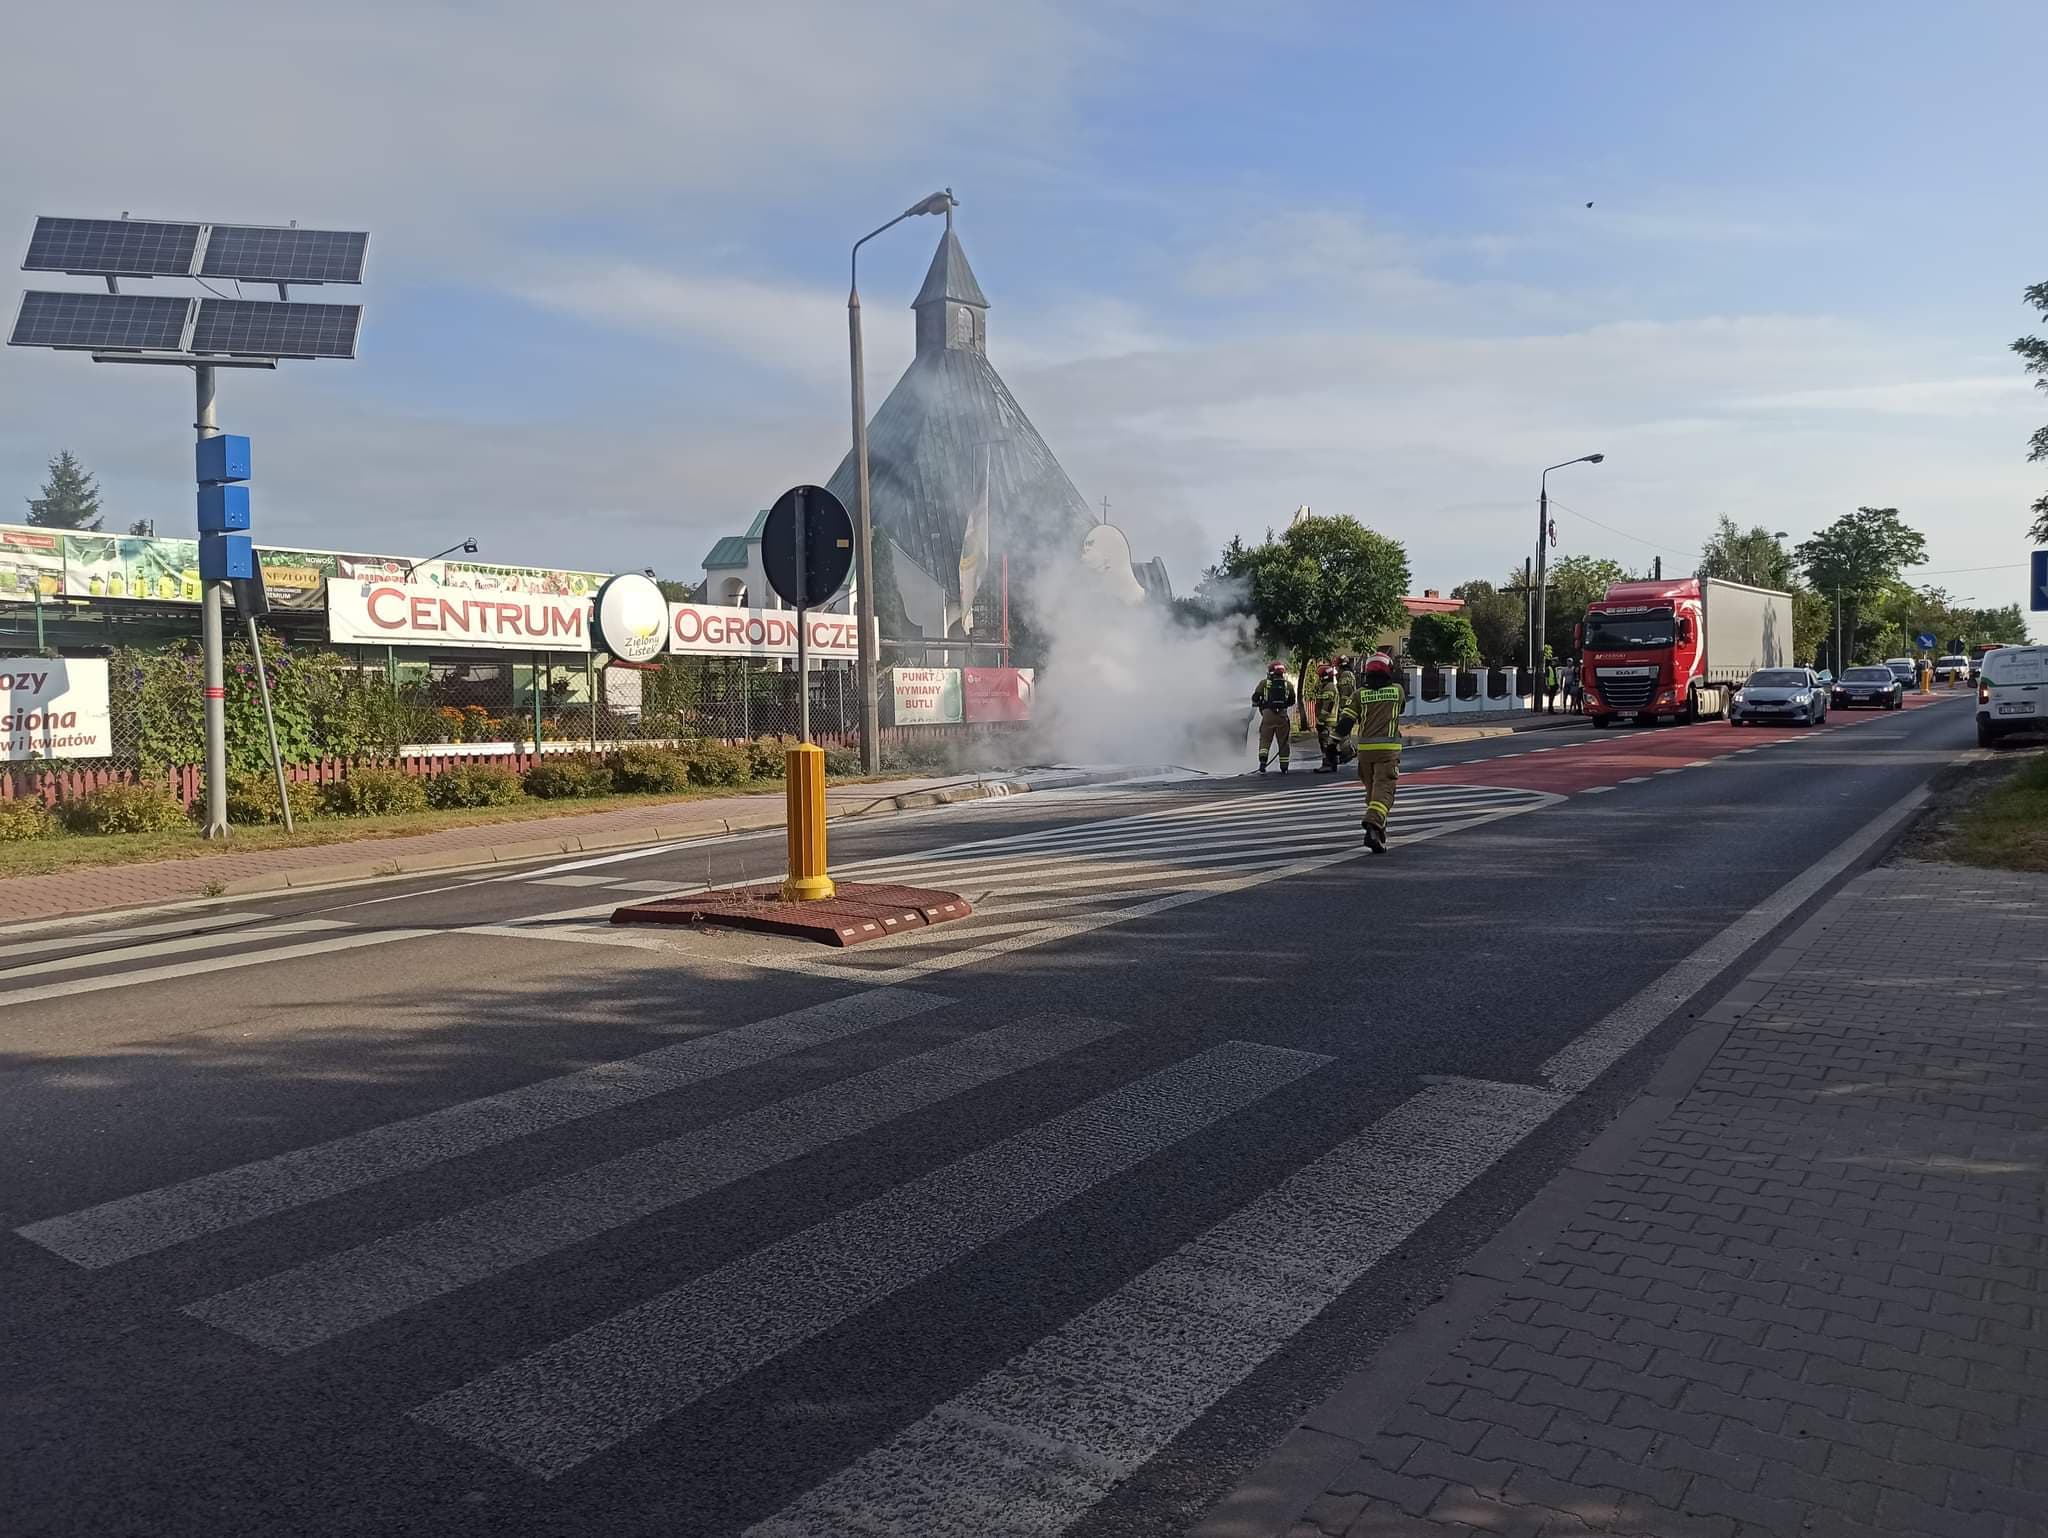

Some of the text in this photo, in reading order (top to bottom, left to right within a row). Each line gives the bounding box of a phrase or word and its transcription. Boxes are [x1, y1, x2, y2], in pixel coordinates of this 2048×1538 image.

[367, 587, 582, 637] CENTRUM
[675, 608, 857, 648] OGRODNICZE
[624, 635, 660, 648] Zielony
[628, 645, 656, 657] Listek
[902, 672, 935, 681] PUNKT
[895, 685, 941, 695] WYMIANY
[905, 699, 933, 708] BUTLI
[28, 732, 97, 750] kwiatów
